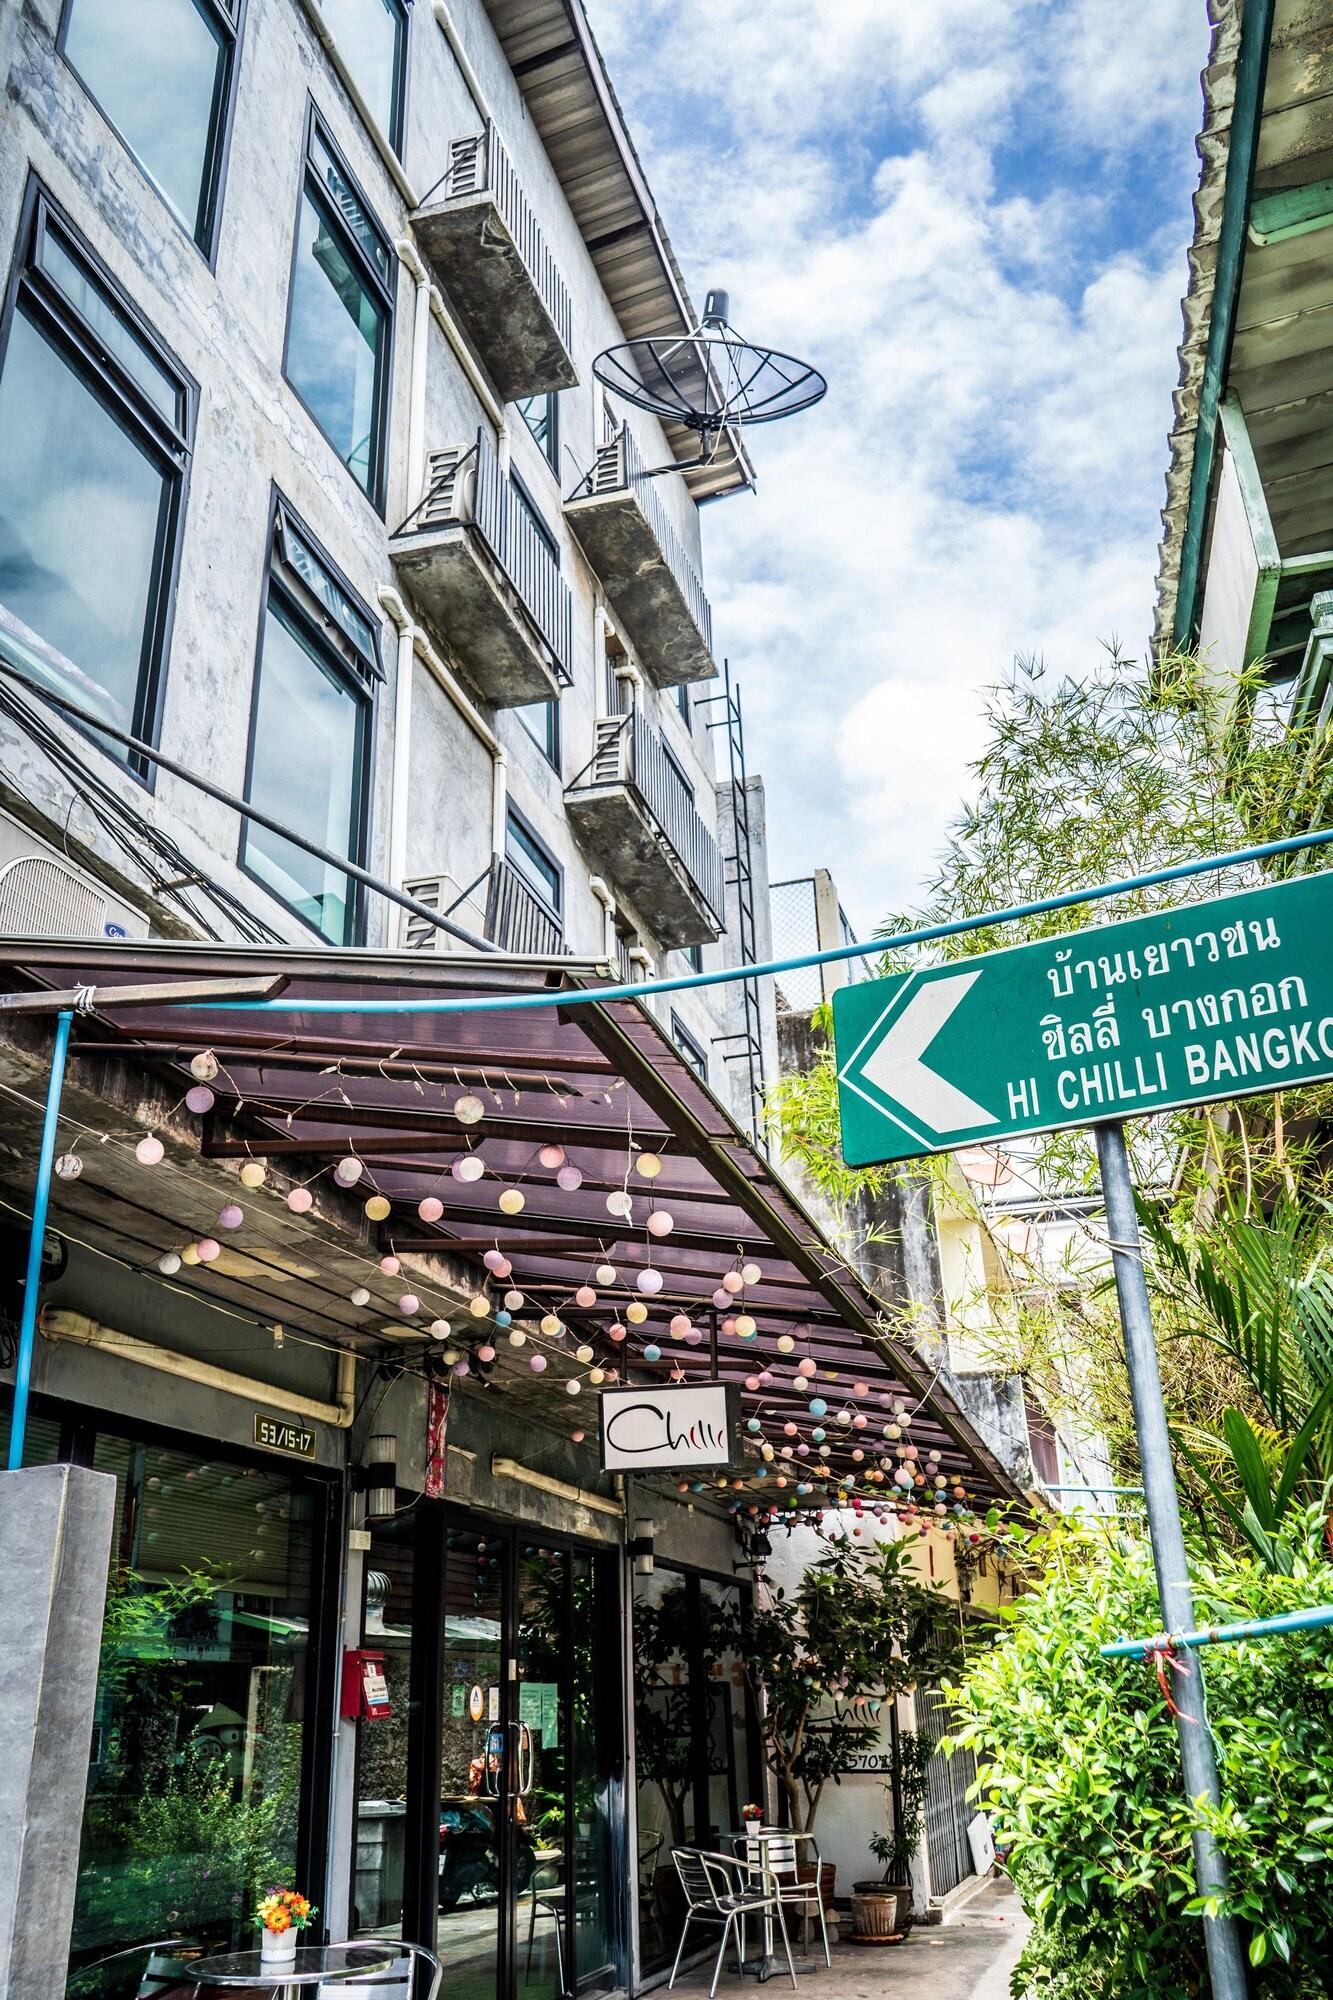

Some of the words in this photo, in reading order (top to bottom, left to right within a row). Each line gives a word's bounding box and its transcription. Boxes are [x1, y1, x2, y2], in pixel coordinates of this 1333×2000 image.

[1047, 917, 1281, 998] บ้านเยาวชน
[1039, 992, 1121, 1061] ชิลลี่
[1141, 975, 1309, 1039] บางกอก
[1007, 1077, 1041, 1120] HI
[1057, 1052, 1168, 1110] CHILLI
[261, 1422, 311, 1451] 53/15-17
[606, 1403, 724, 1454] Chilli
